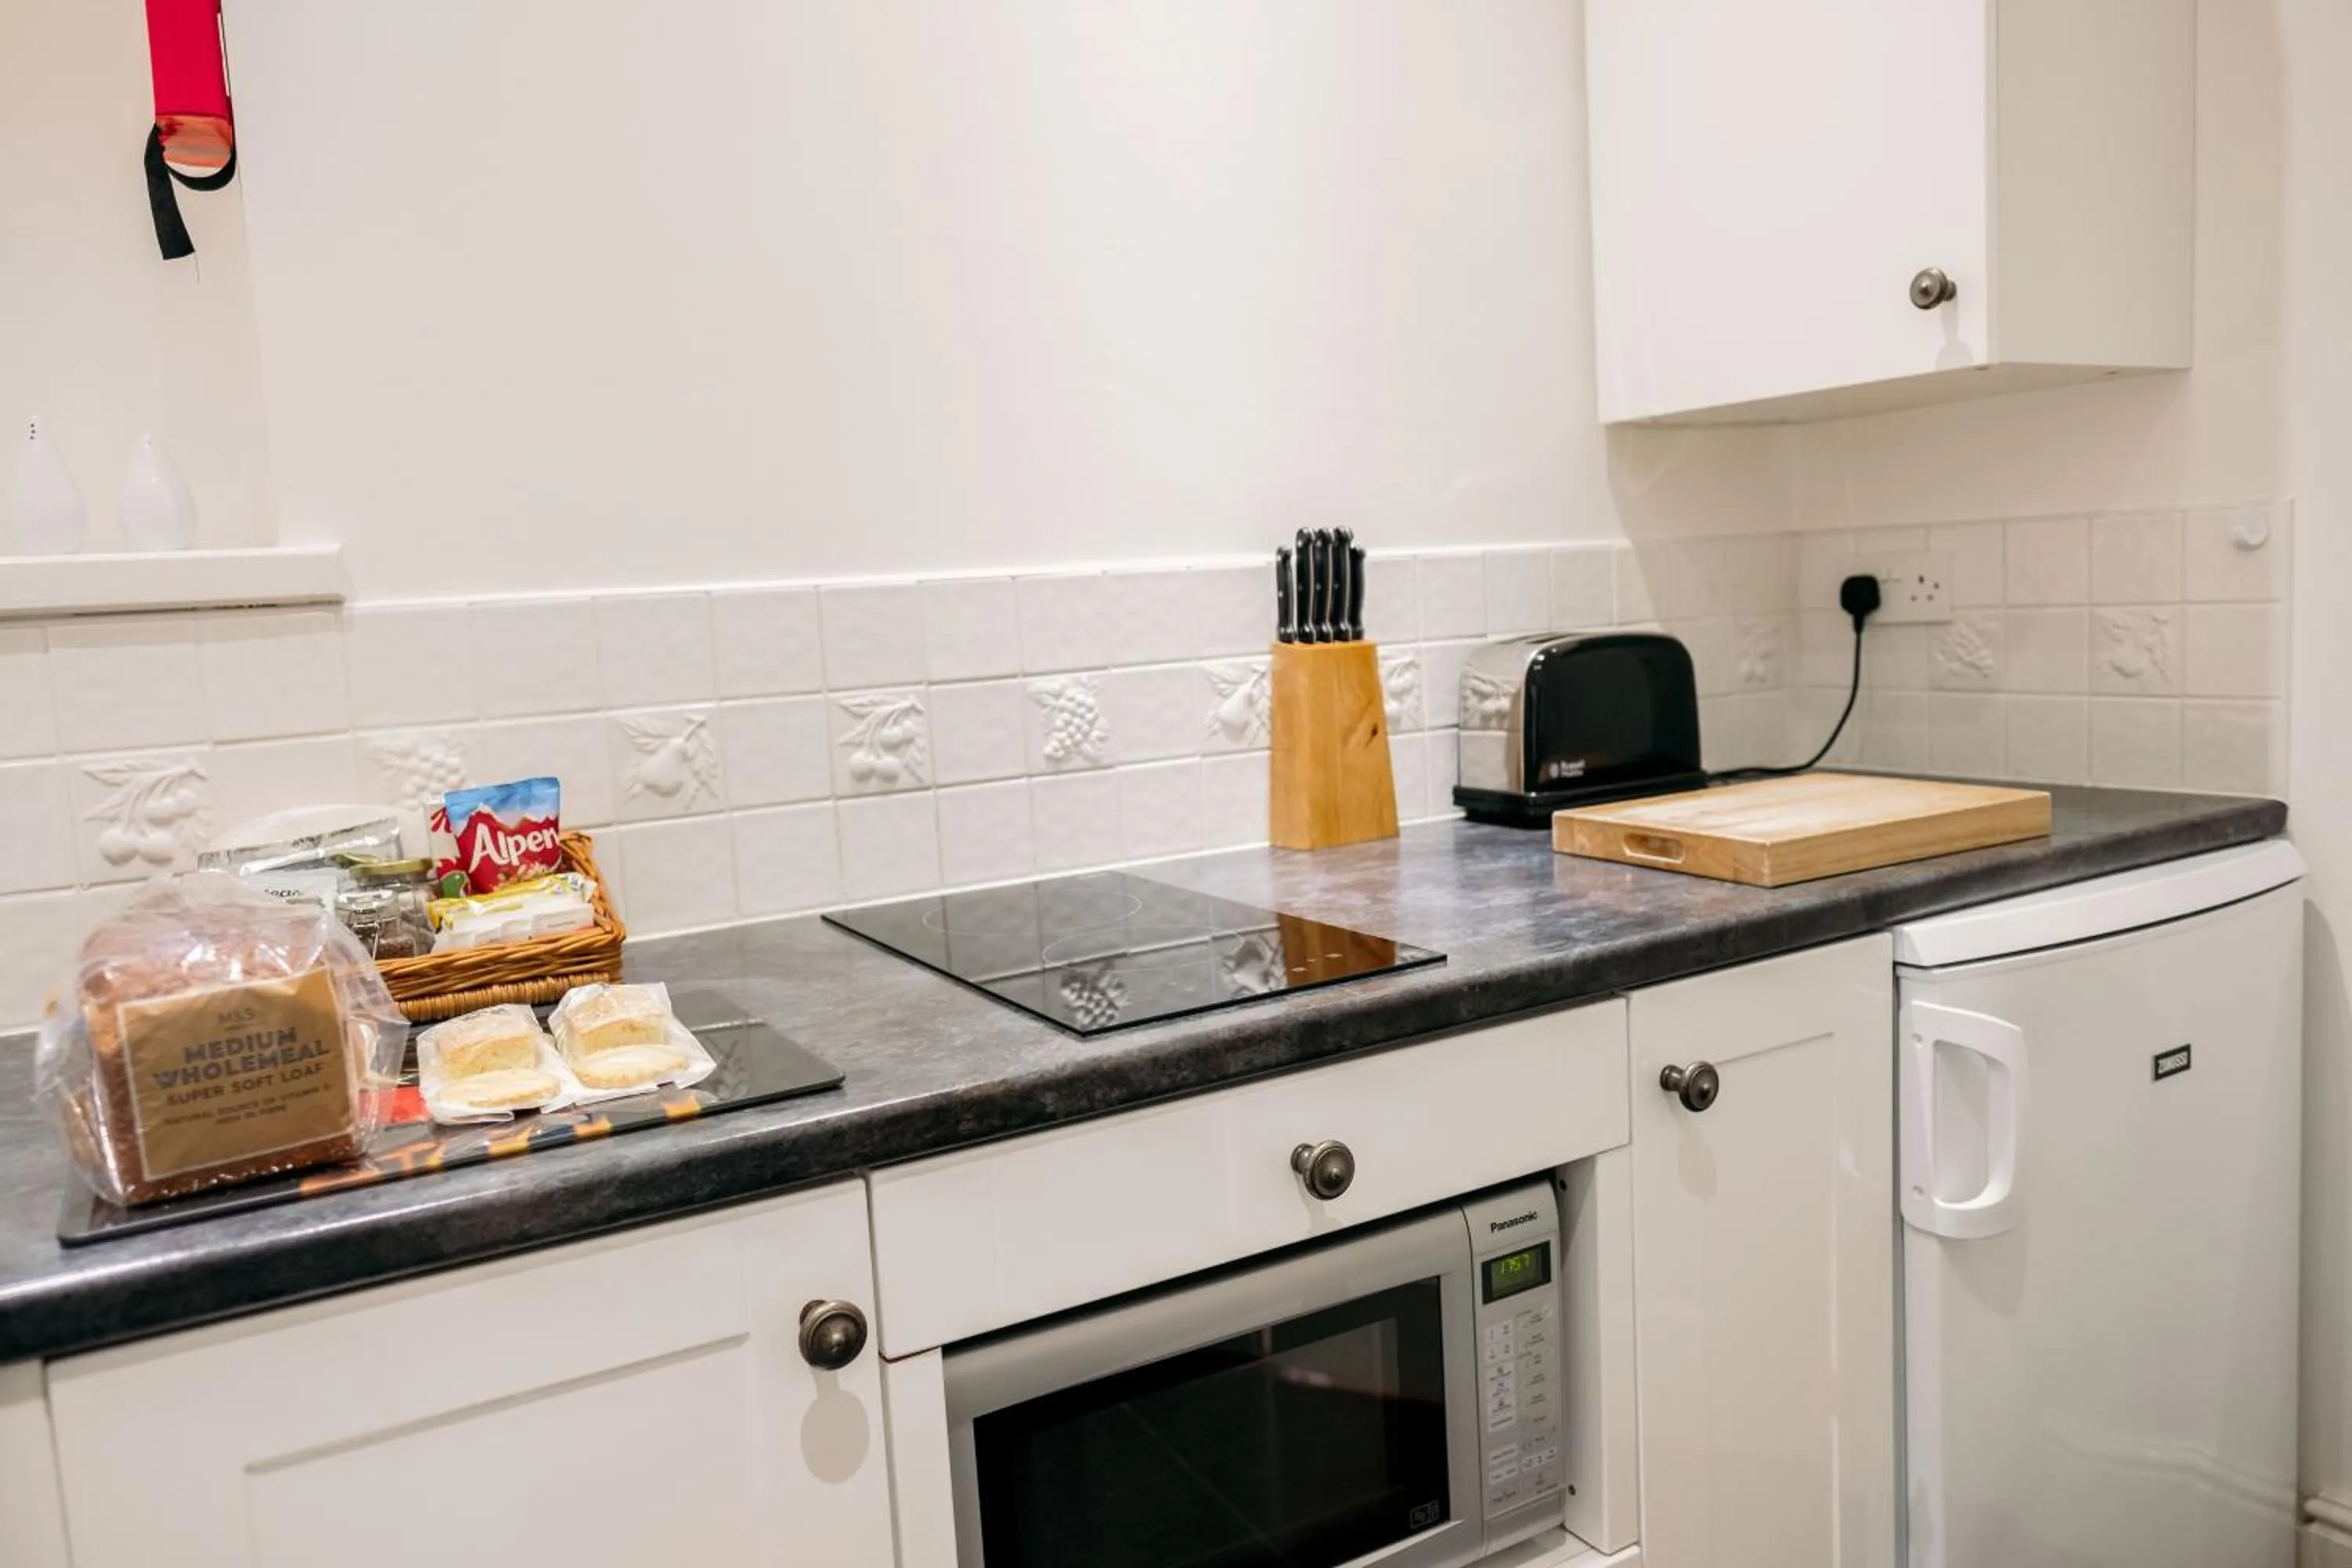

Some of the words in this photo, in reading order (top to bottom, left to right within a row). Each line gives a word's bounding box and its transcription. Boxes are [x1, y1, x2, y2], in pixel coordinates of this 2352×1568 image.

[468, 822, 560, 874] Alpen
[153, 1040, 330, 1090] WHOLEMEAL
[183, 1026, 298, 1063] MEDIUM
[166, 1085, 225, 1106] SUPER
[231, 1075, 274, 1094] SOFT
[281, 1062, 324, 1083] LOAF
[1490, 1210, 1538, 1233] Panasonic
